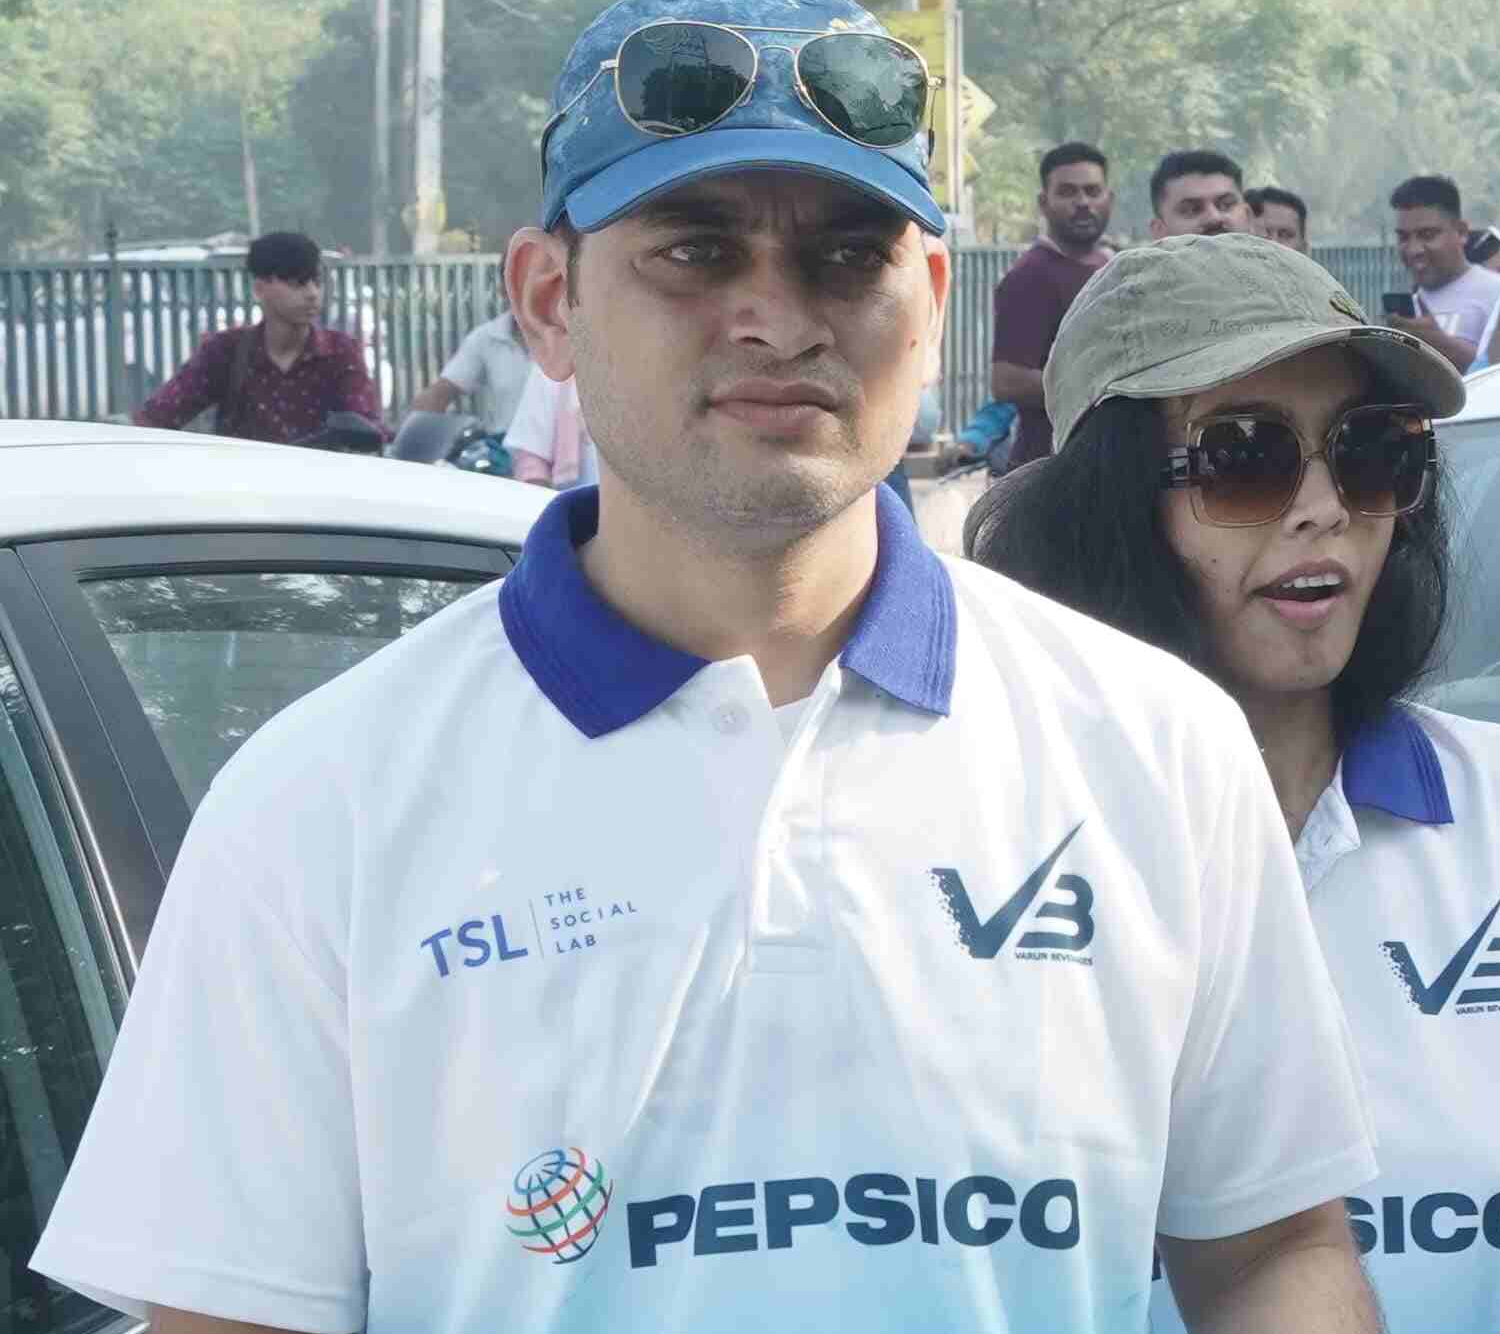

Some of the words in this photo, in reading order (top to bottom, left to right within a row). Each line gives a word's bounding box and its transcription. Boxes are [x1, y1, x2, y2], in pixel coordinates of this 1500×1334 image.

[543, 887, 587, 907] THE
[550, 900, 638, 930] SOCIAL
[420, 914, 529, 978] TSL
[555, 933, 598, 955] LAB
[626, 1171, 1081, 1269] PEPSICO
